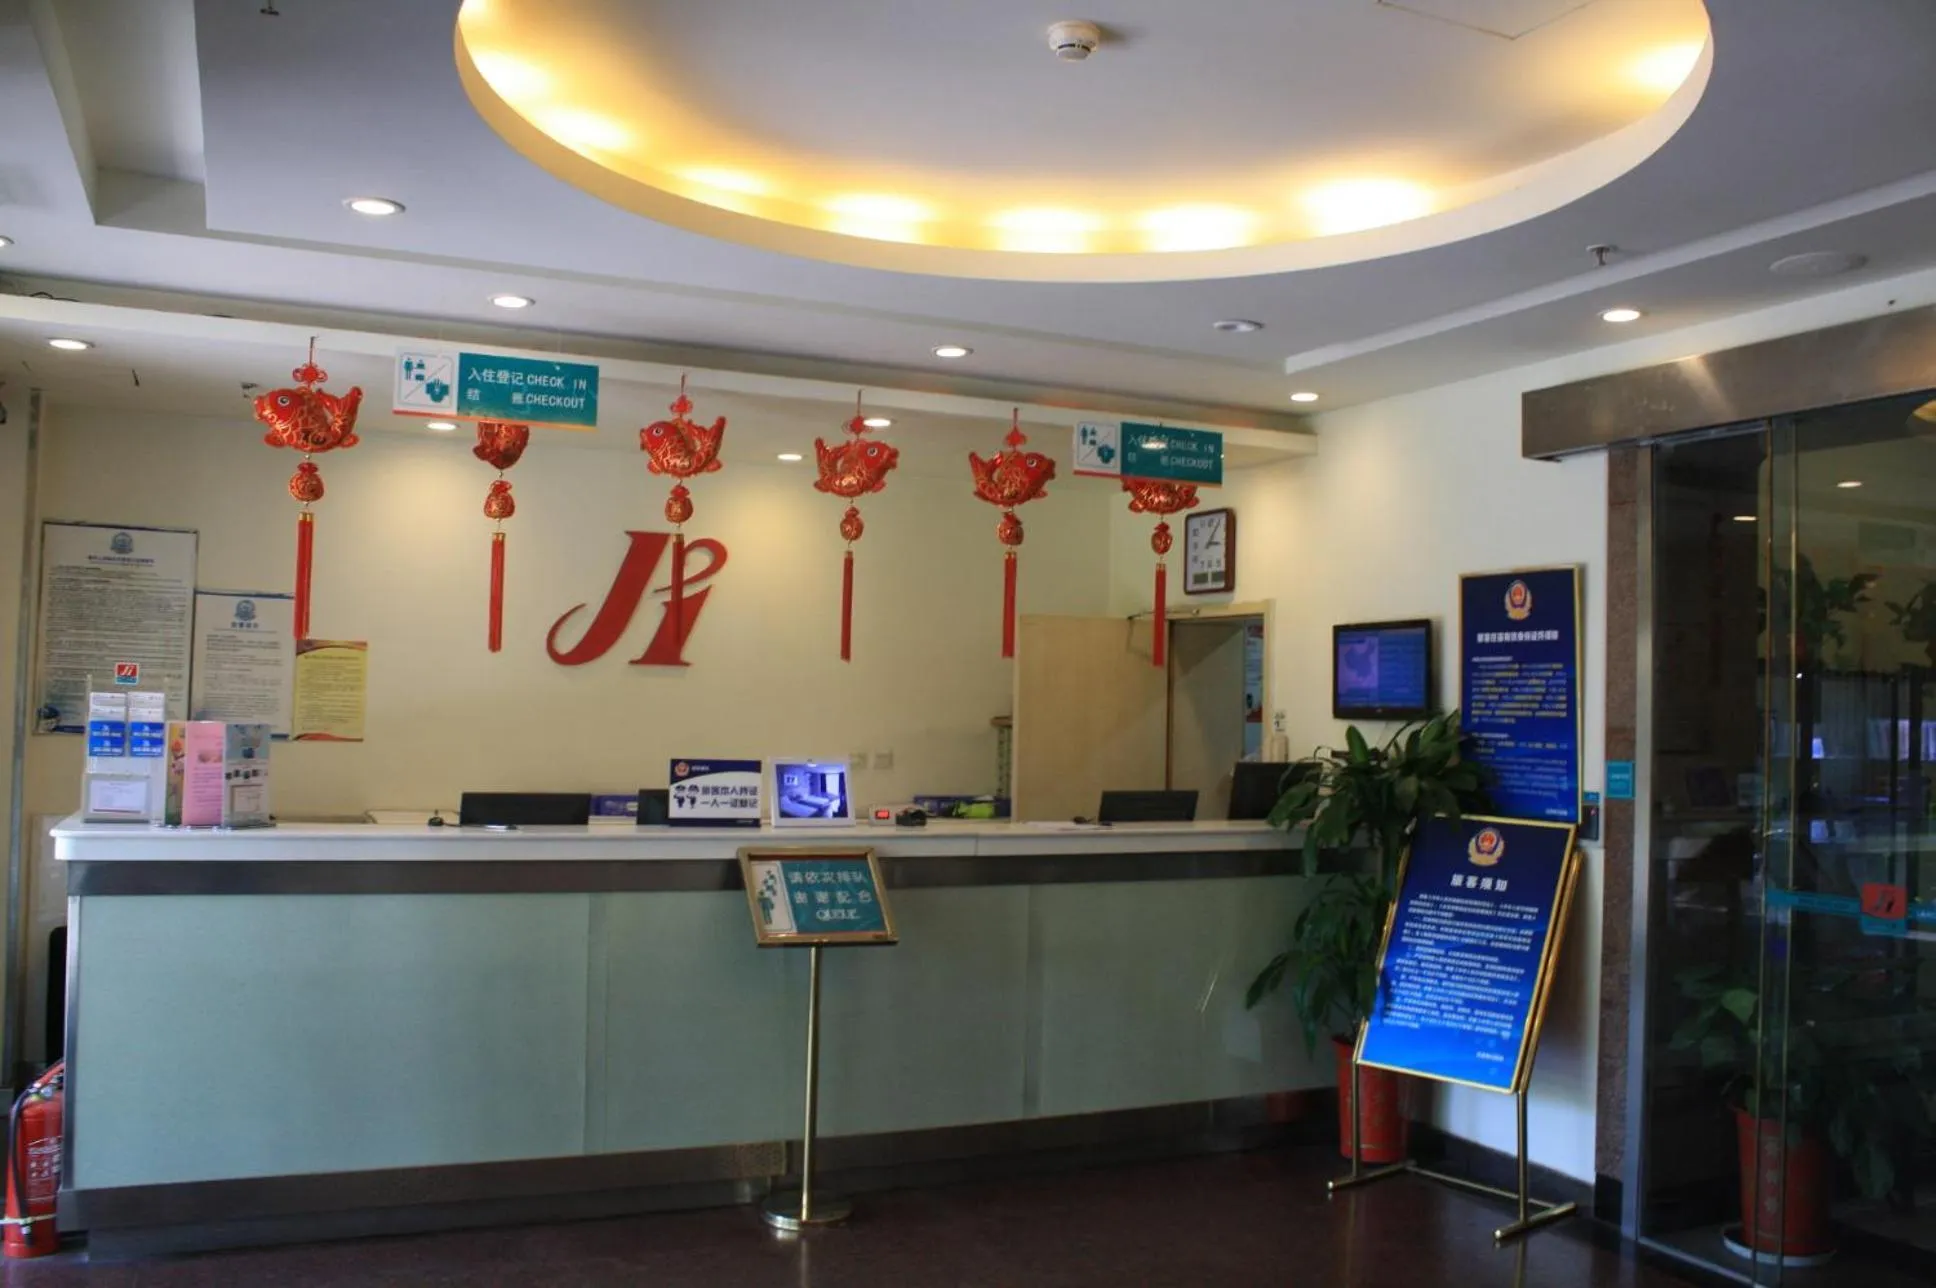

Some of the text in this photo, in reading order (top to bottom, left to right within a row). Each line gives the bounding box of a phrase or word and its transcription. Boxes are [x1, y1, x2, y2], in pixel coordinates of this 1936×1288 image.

[468, 367, 587, 390] 入住登记 CHECK IN
[525, 393, 586, 409] CHECKOUT
